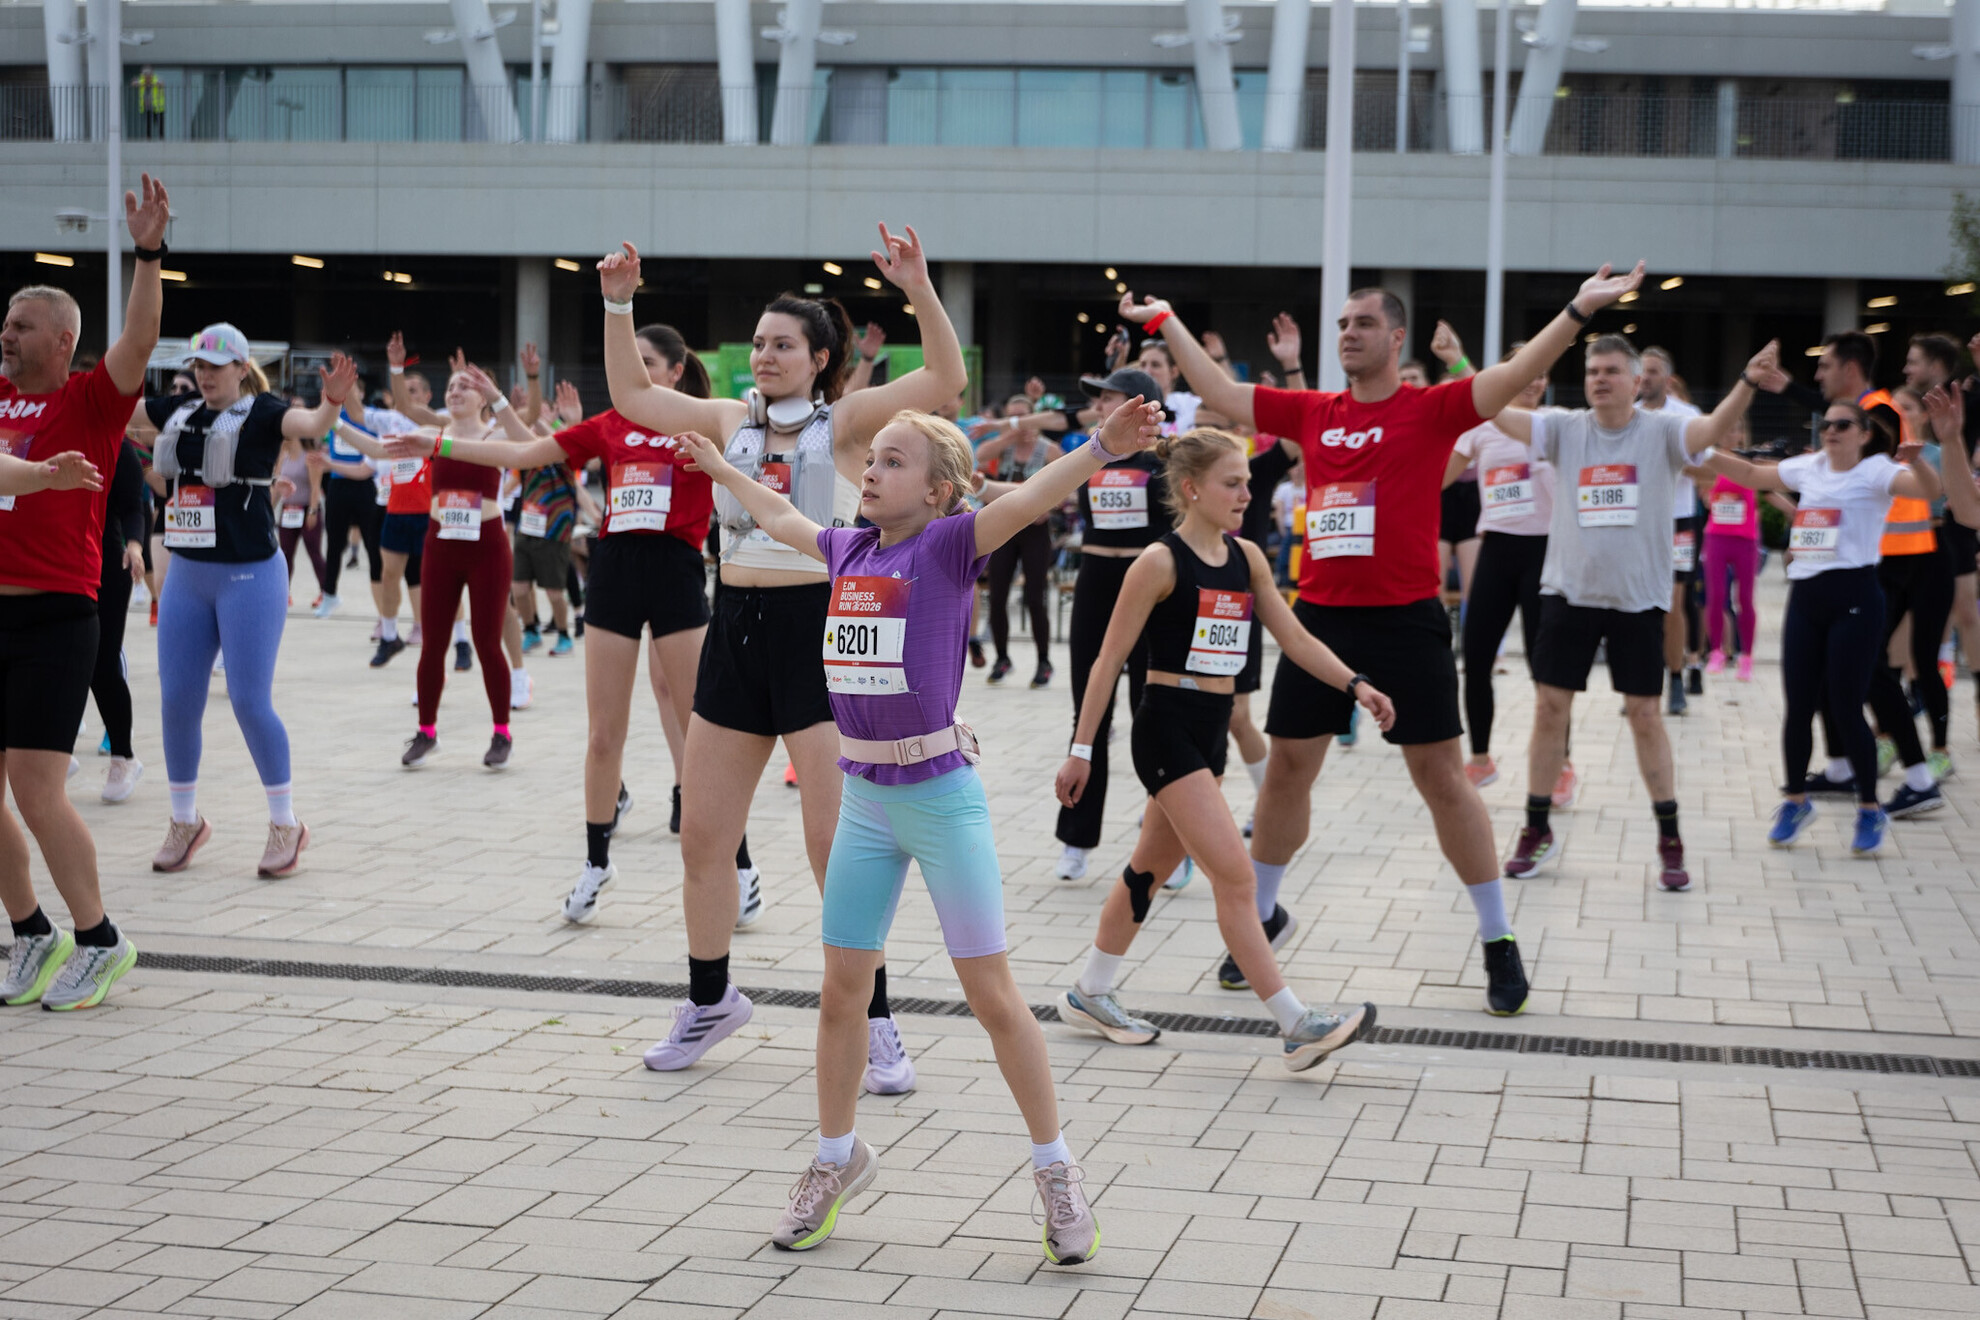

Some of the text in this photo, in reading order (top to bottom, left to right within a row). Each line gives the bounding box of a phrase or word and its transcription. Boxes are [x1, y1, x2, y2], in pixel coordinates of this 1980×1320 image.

[621, 489, 653, 508] 5873
[1100, 491, 1132, 508] 6353
[1591, 488, 1624, 505] 5186
[1319, 512, 1355, 533] 5621
[842, 581, 857, 591] E.ON
[840, 592, 876, 602] BUSINESS
[838, 602, 882, 612] RUN 2026
[827, 632, 833, 643] 4
[837, 624, 878, 655] 6201
[1209, 624, 1239, 647] 6034
